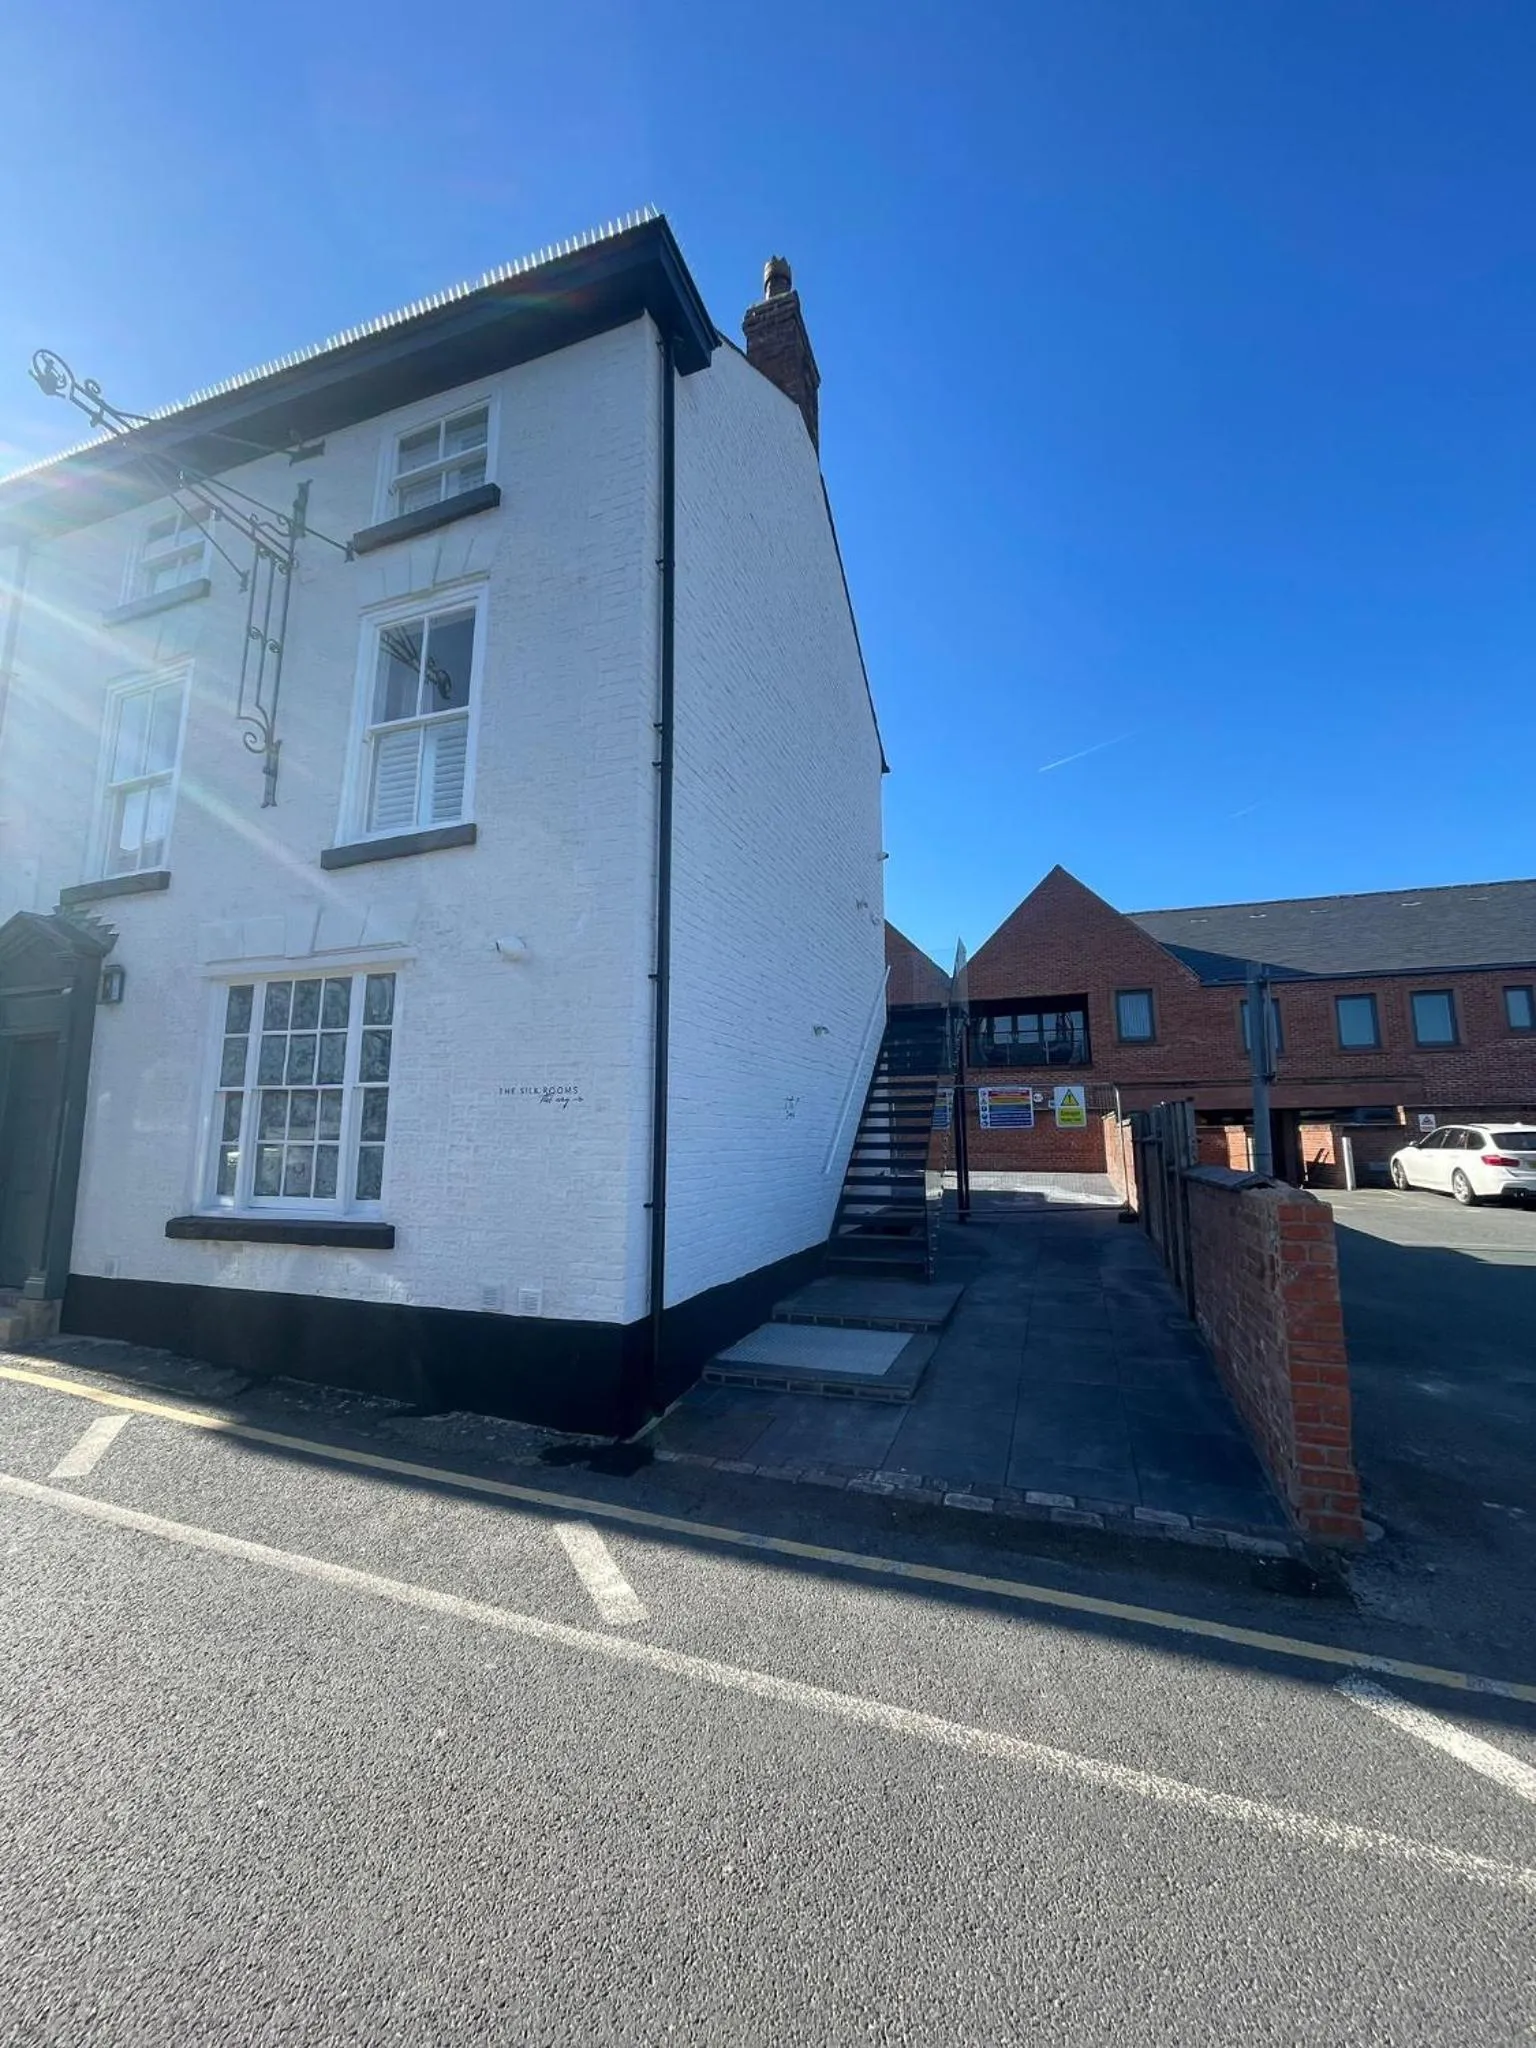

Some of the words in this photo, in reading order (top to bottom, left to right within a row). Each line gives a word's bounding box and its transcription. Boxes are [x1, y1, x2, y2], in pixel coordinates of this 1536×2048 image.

[499, 1087, 516, 1096] THE
[520, 1087, 540, 1095] SILK
[542, 1086, 579, 1095] ROOMS
